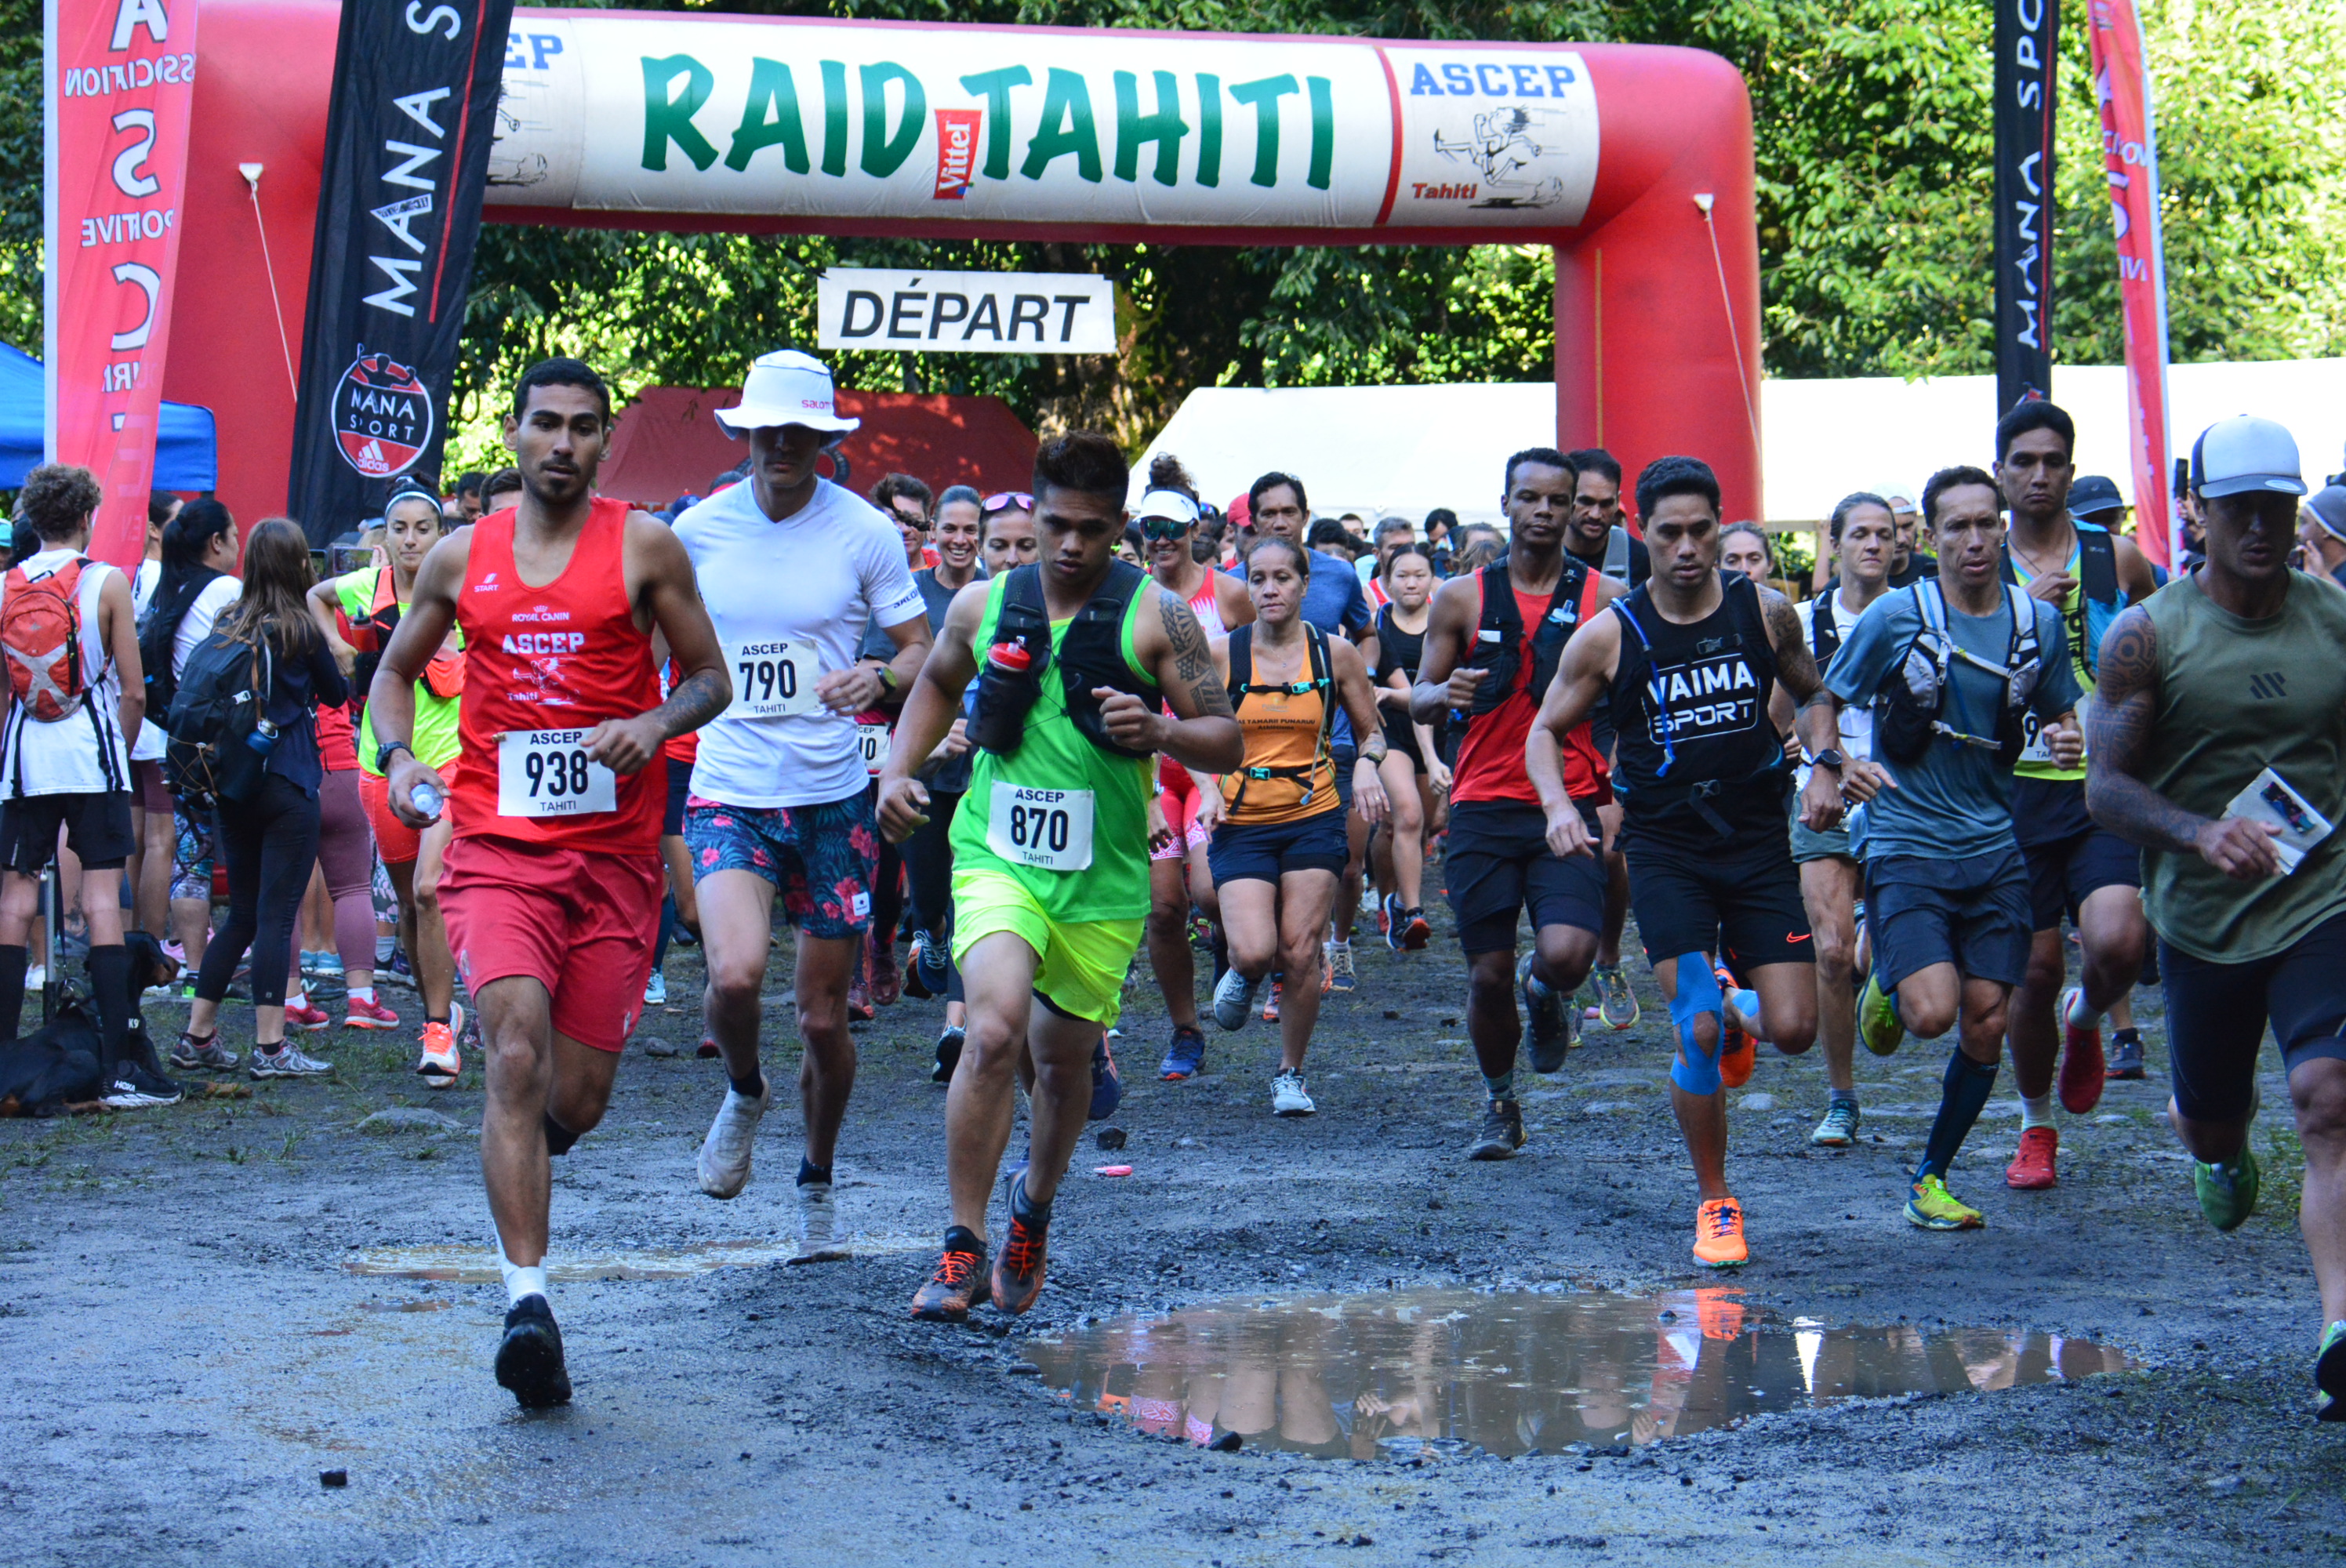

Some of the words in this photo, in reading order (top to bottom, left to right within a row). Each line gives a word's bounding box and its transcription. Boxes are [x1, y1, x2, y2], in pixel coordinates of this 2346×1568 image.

[1410, 62, 1576, 99] ASCEP
[641, 53, 926, 178] RAID
[960, 64, 1334, 191] TAHITI
[938, 121, 971, 191] Vittel
[1411, 182, 1477, 201] Tahiti
[361, 86, 450, 318] MANA
[2015, 151, 2042, 349] MANA
[840, 278, 1091, 343] DÉPART
[358, 457, 390, 472] adidas
[474, 584, 499, 593] START
[512, 612, 539, 622] ROYAL
[541, 612, 569, 621] CANIN
[502, 632, 584, 654] ASCEP
[742, 643, 788, 655] ASCEP
[739, 659, 797, 702] 790
[1647, 661, 1755, 704] VAIMA
[507, 691, 539, 701] Tahiti
[754, 703, 786, 713] TAHITI
[1654, 699, 1755, 733] SPORT
[530, 731, 583, 745] ASCEP
[526, 750, 588, 797] 938
[540, 800, 576, 811] TAHITI
[1015, 789, 1065, 803] ASCEP
[1011, 804, 1069, 852] 870
[1022, 851, 1053, 865] TAHITI
[114, 1080, 136, 1092] HOKA
